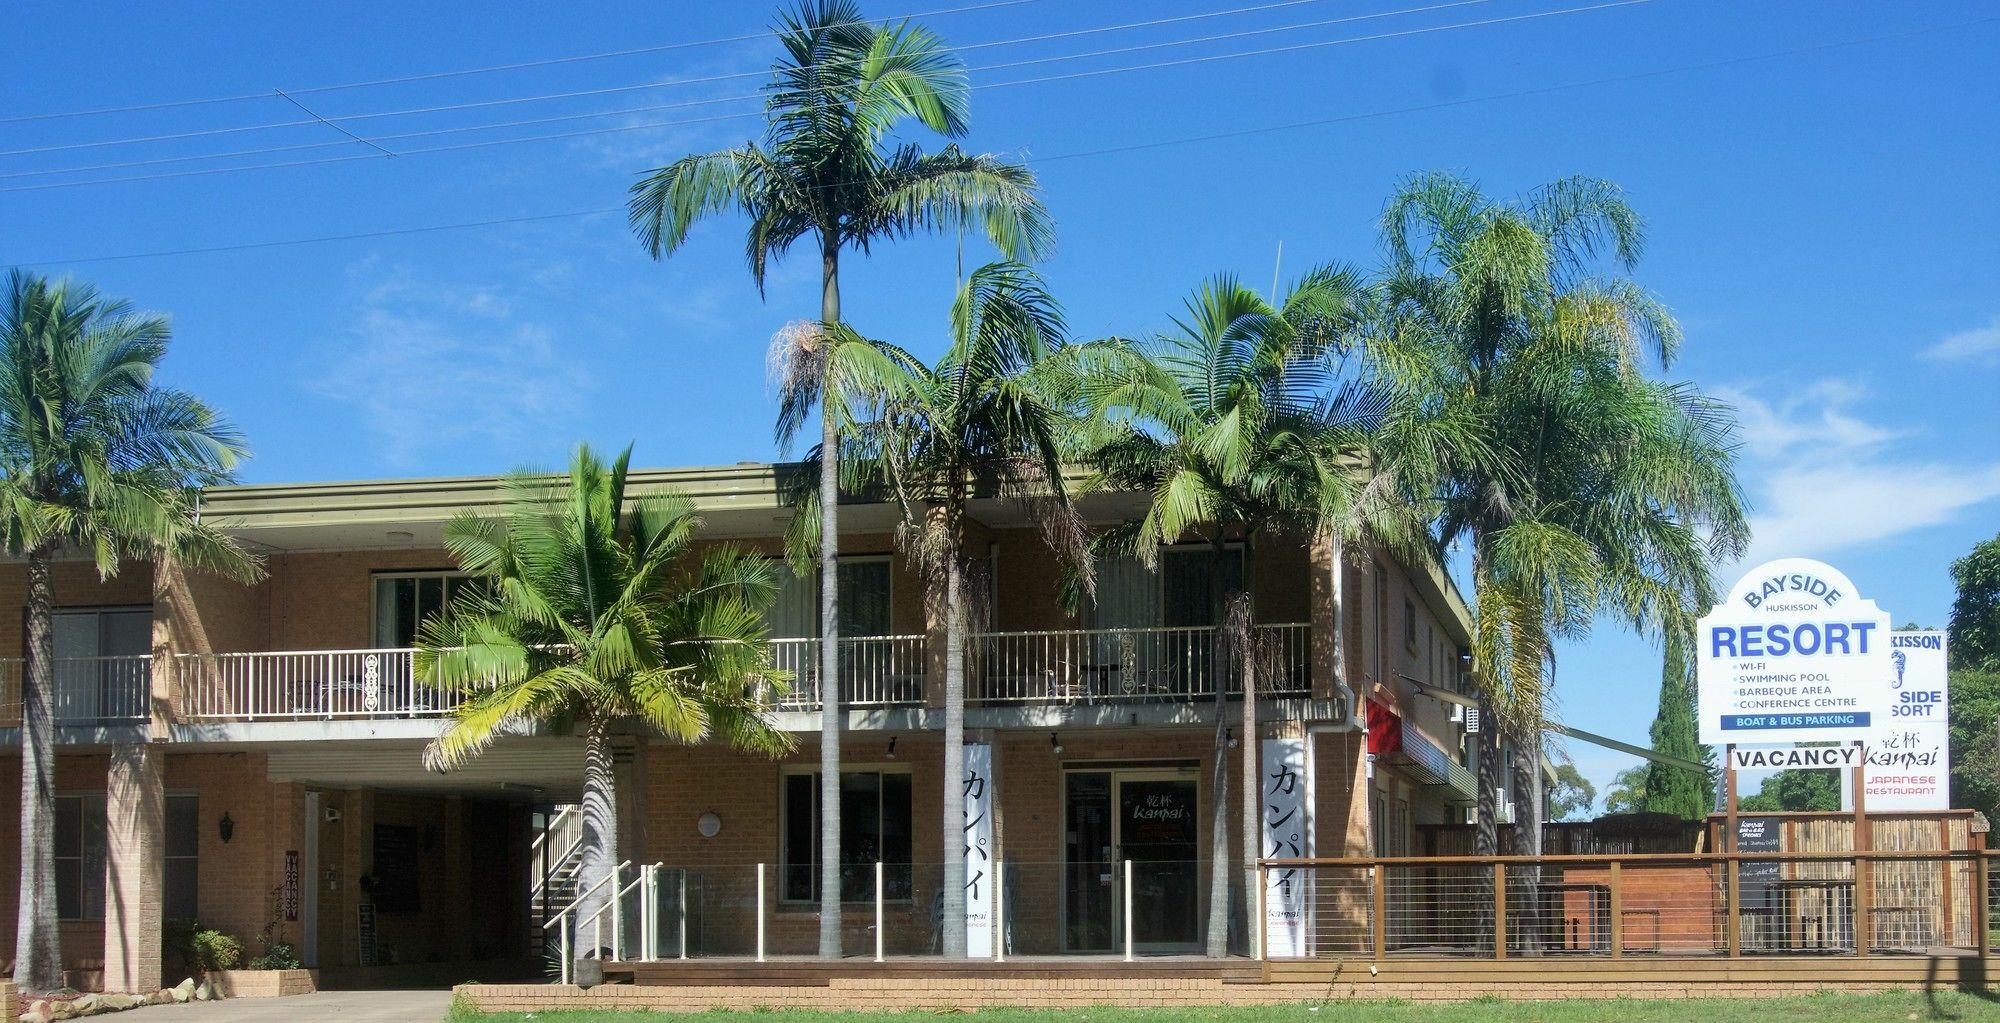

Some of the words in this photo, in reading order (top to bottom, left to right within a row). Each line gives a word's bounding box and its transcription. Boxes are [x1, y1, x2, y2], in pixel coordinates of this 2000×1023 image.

[1744, 574, 1842, 609] BAYSIDE
[1766, 603, 1818, 612] HUSKISSON
[1712, 622, 1876, 658] RESORT
[1740, 662, 1766, 671] WI-FI
[1739, 674, 1797, 684] SWIMMING
[1800, 673, 1830, 682] POOL
[1739, 686, 1798, 697] BARBEQUE
[1801, 685, 1832, 695] AREA
[1900, 691, 1942, 703] SIDE
[1739, 699, 1811, 709] CONFERENCE
[1814, 697, 1857, 707] CENTRE
[1736, 717, 1766, 727] BOAT
[1769, 717, 1778, 726] &
[1781, 716, 1803, 726] BUS
[1805, 715, 1855, 725] PARKING
[1736, 748, 1855, 767] VACANCY
[1867, 776, 1936, 785] JAPANESE
[1866, 787, 1937, 795] RESTAURANT
